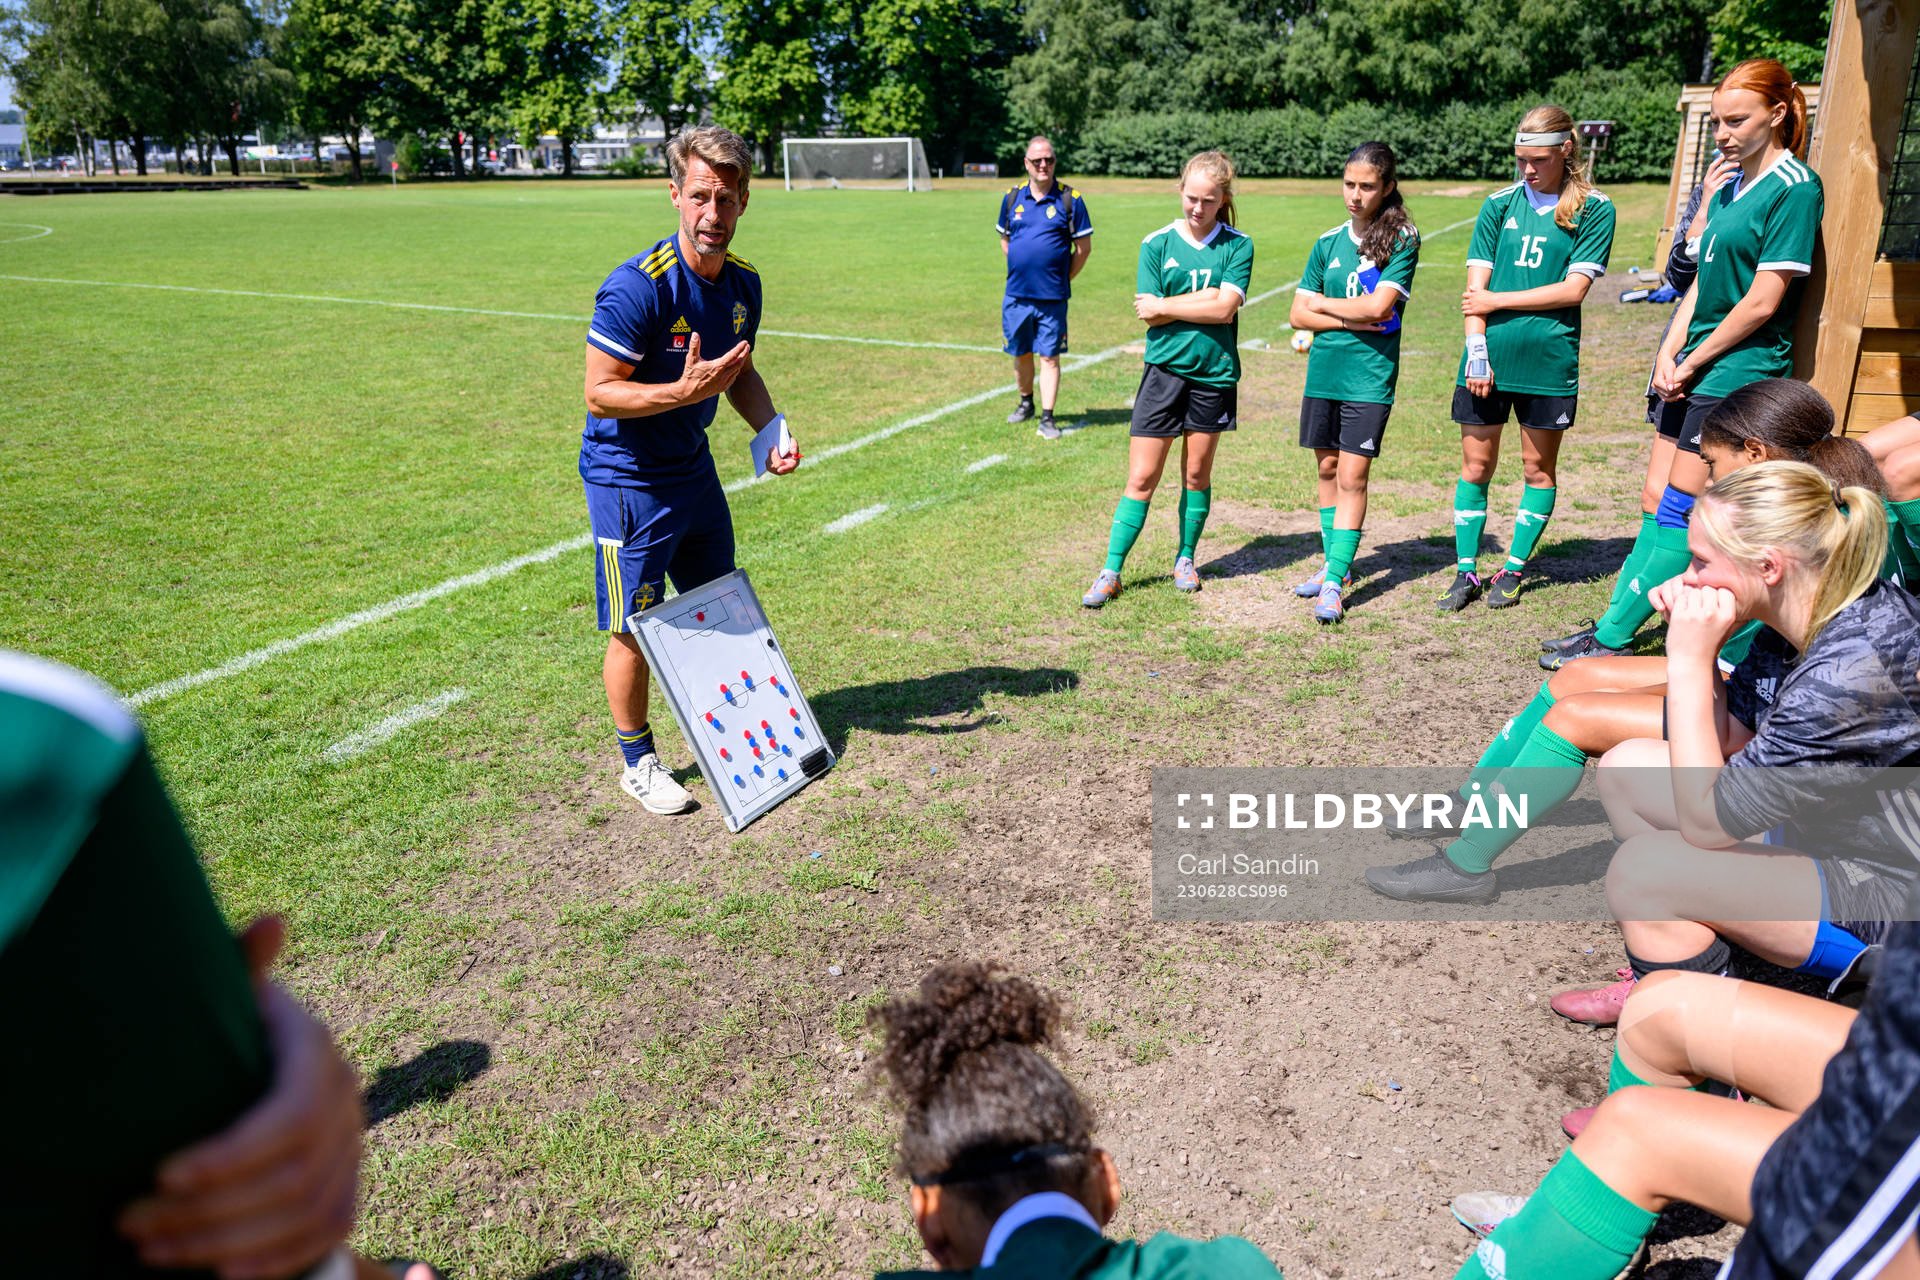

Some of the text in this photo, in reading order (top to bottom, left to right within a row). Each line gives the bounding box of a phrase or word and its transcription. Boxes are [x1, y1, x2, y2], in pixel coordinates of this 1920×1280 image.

[1514, 234, 1548, 269] 15
[1189, 268, 1212, 292] 17
[1345, 271, 1359, 299] 8
